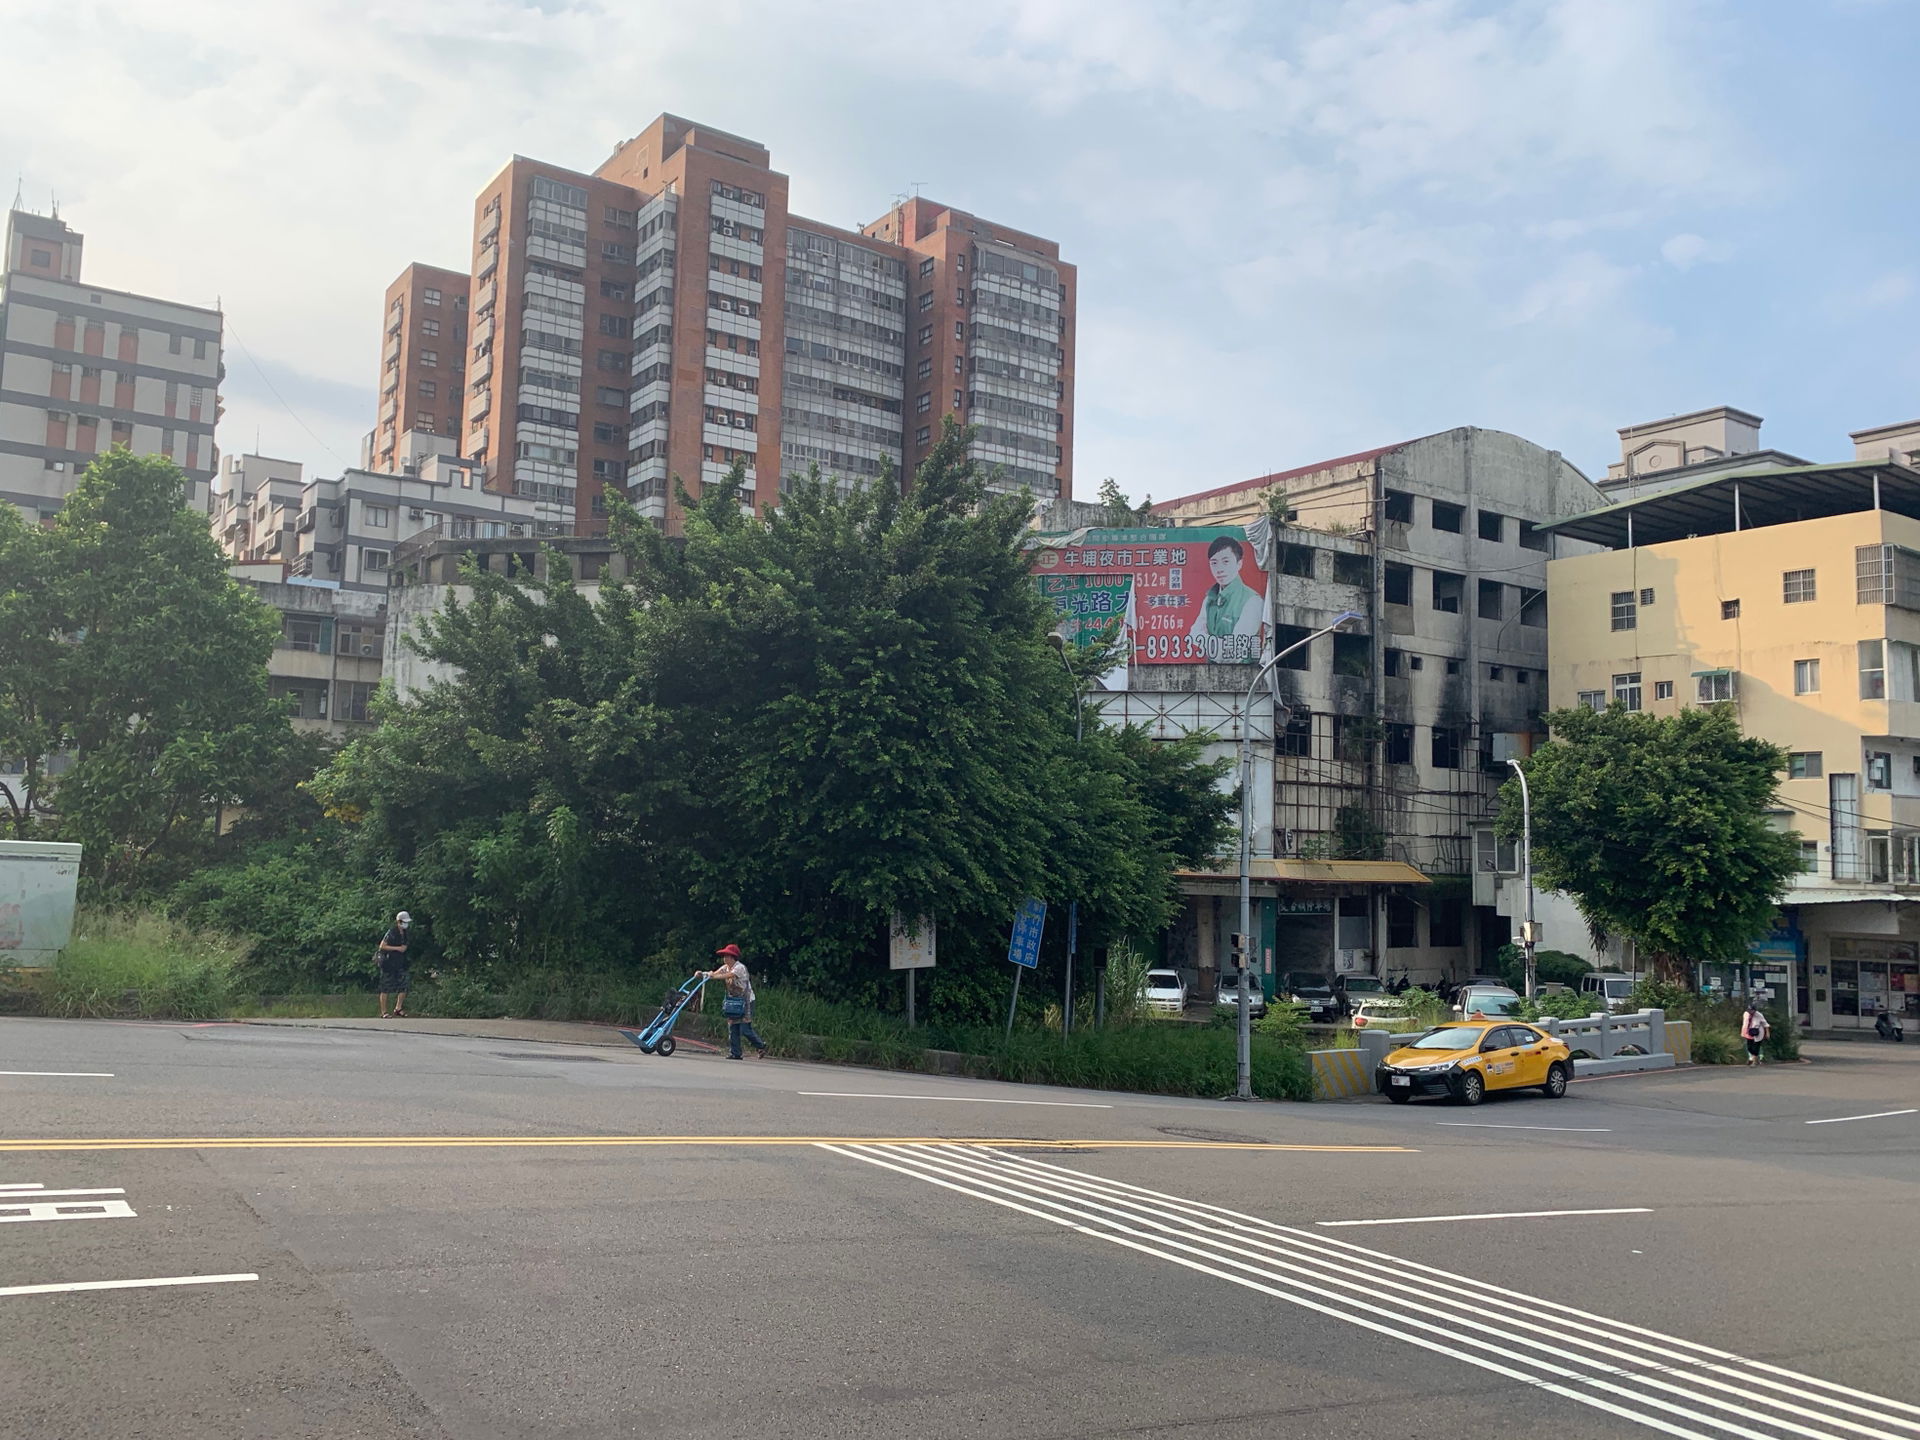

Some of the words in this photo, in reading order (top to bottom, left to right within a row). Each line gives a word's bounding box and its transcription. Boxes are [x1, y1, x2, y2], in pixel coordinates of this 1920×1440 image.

[1064, 549, 1187, 566] 牛埔夜市工業地
